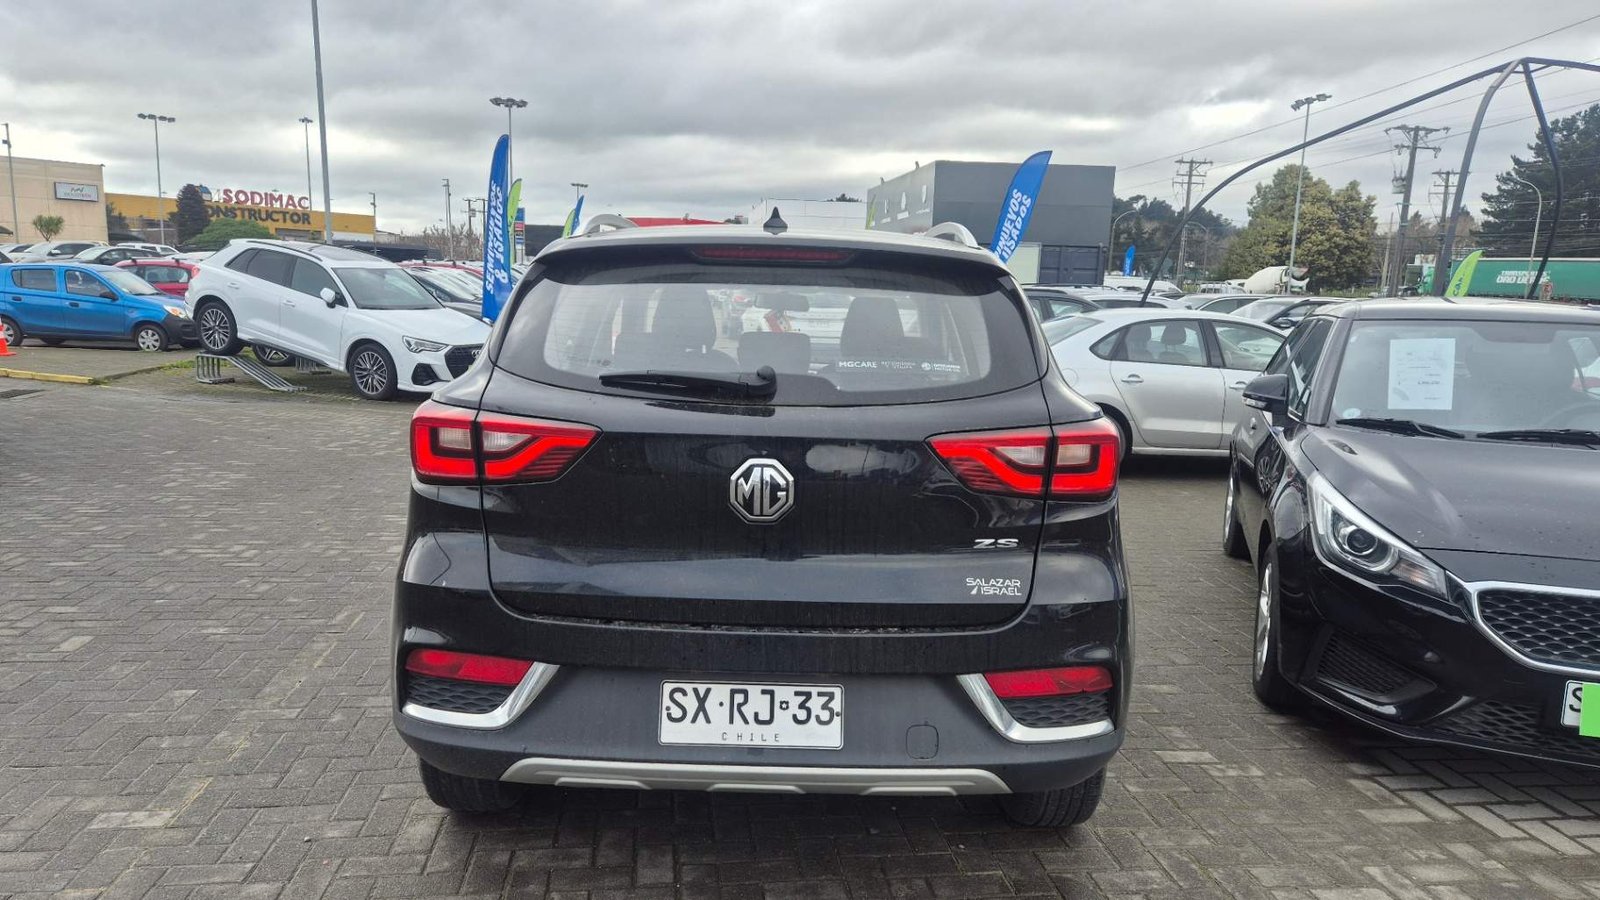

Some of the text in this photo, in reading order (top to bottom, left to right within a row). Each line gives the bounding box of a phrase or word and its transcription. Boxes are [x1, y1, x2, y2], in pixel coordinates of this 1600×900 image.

[222, 188, 310, 210] SODIMAC
[206, 204, 311, 225] ONSTRUCTOR
[737, 467, 787, 516] MG
[973, 538, 1019, 549] ZS
[966, 577, 1021, 588] SALAZAR
[980, 586, 1022, 596] ISRAEL
[721, 732, 781, 743] CHILE
